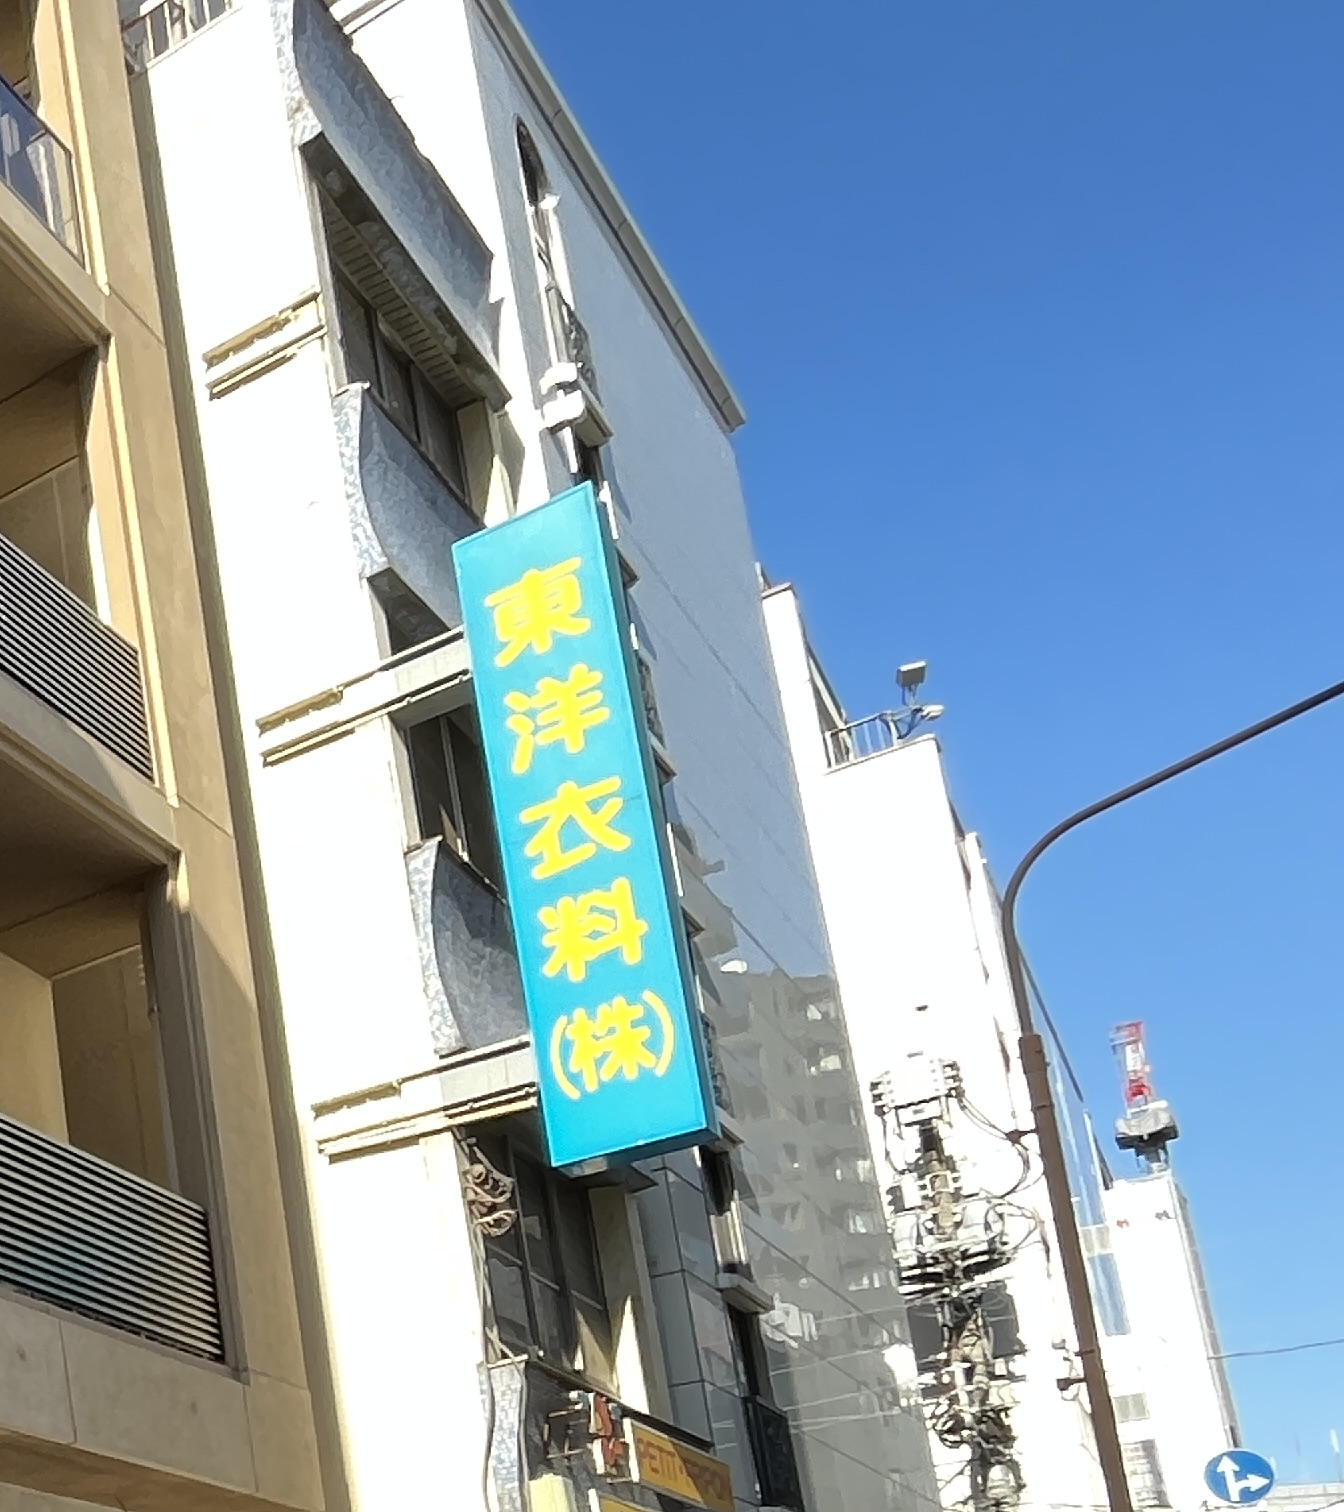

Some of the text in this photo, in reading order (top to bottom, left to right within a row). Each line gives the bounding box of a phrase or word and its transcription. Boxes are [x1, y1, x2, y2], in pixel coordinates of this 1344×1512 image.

[484, 556, 673, 1099] 東洋衣料(株)
